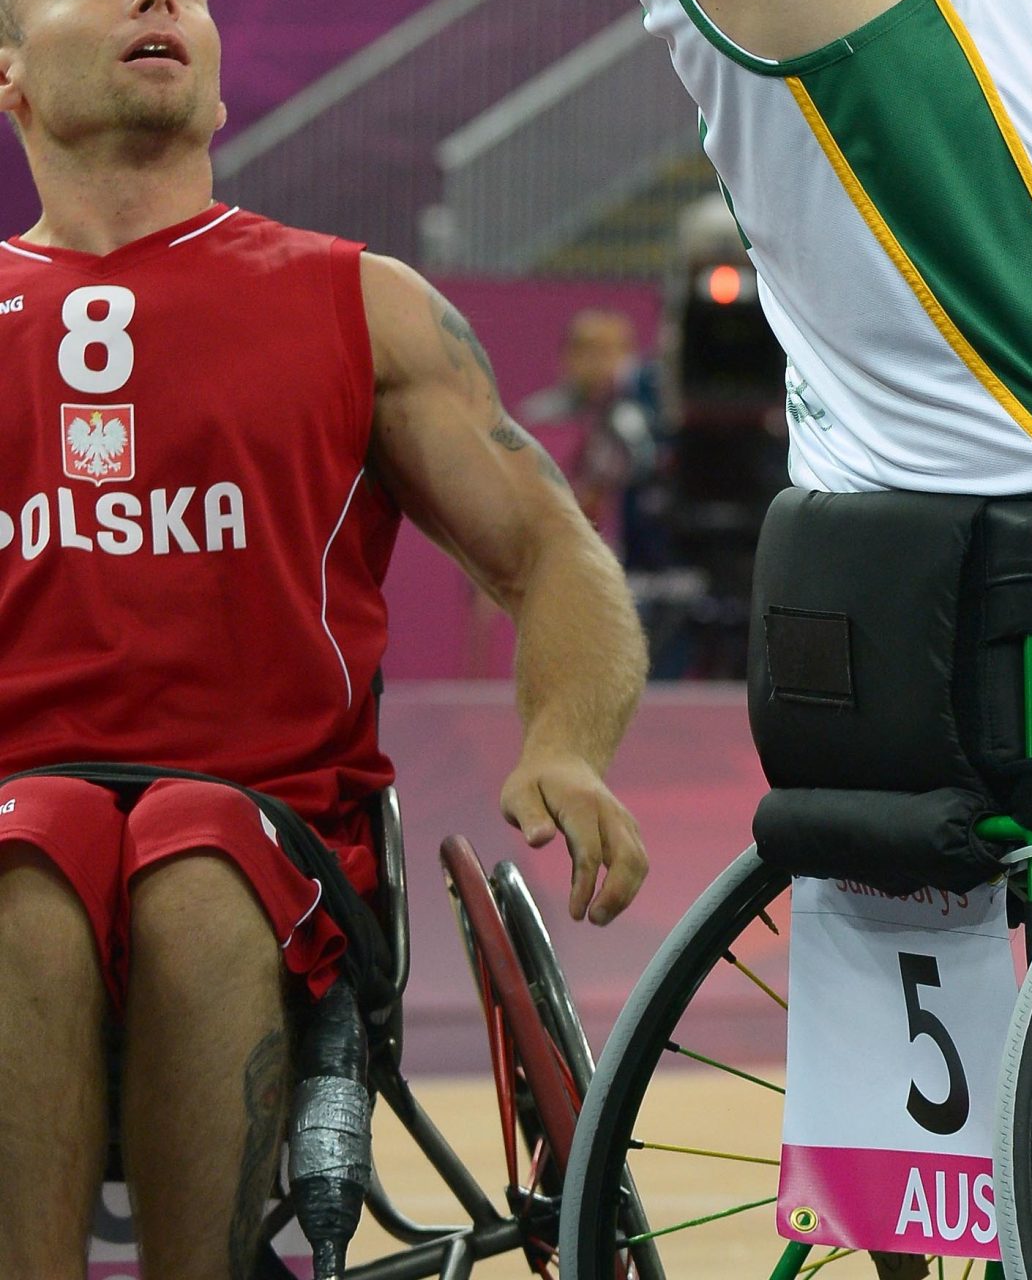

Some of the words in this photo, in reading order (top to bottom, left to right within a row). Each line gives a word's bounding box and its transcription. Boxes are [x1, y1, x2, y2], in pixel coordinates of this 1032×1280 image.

[57, 284, 137, 395] 8
[897, 950, 971, 1136] 5
[895, 1166, 998, 1244] AUS
